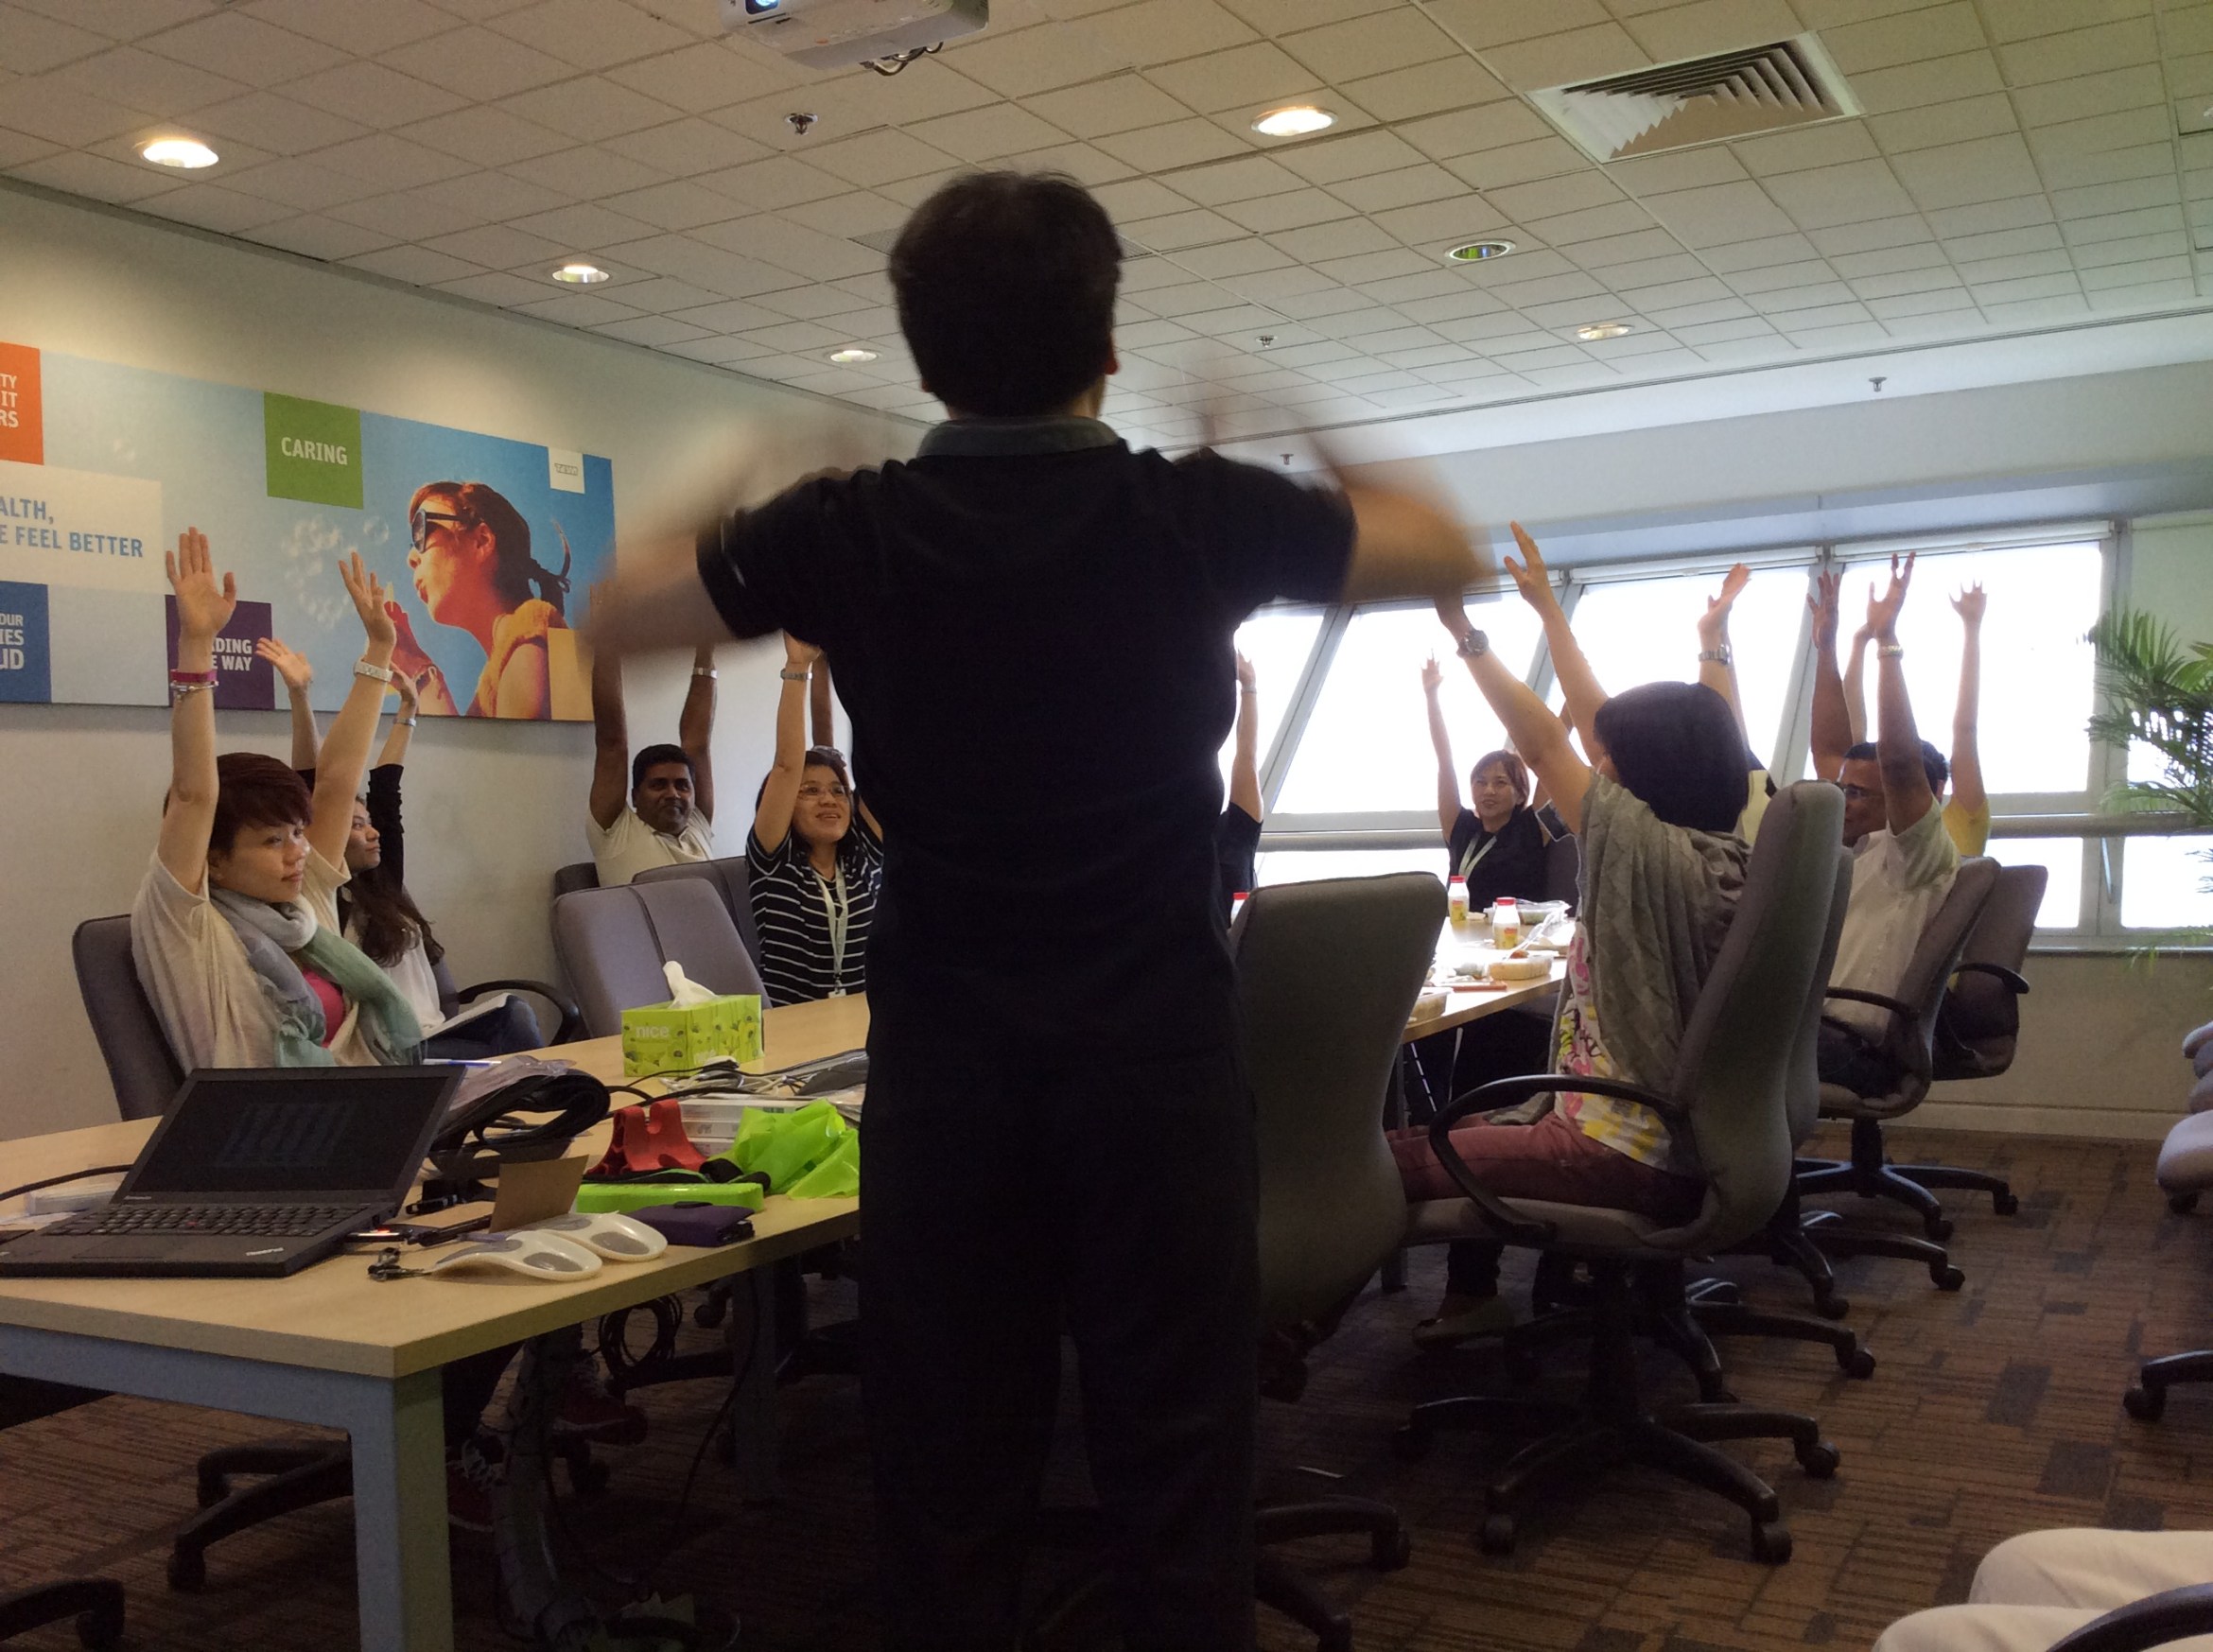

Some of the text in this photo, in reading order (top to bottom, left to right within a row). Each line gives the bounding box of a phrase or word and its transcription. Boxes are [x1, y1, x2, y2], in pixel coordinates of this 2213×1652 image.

[281, 436, 348, 465] CARING
[0, 496, 54, 524] ALTH,
[15, 526, 62, 549] FEEL
[69, 531, 143, 558] BETTER
[213, 637, 253, 654] DING
[221, 655, 253, 671] WAY
[636, 1025, 670, 1038] nice
